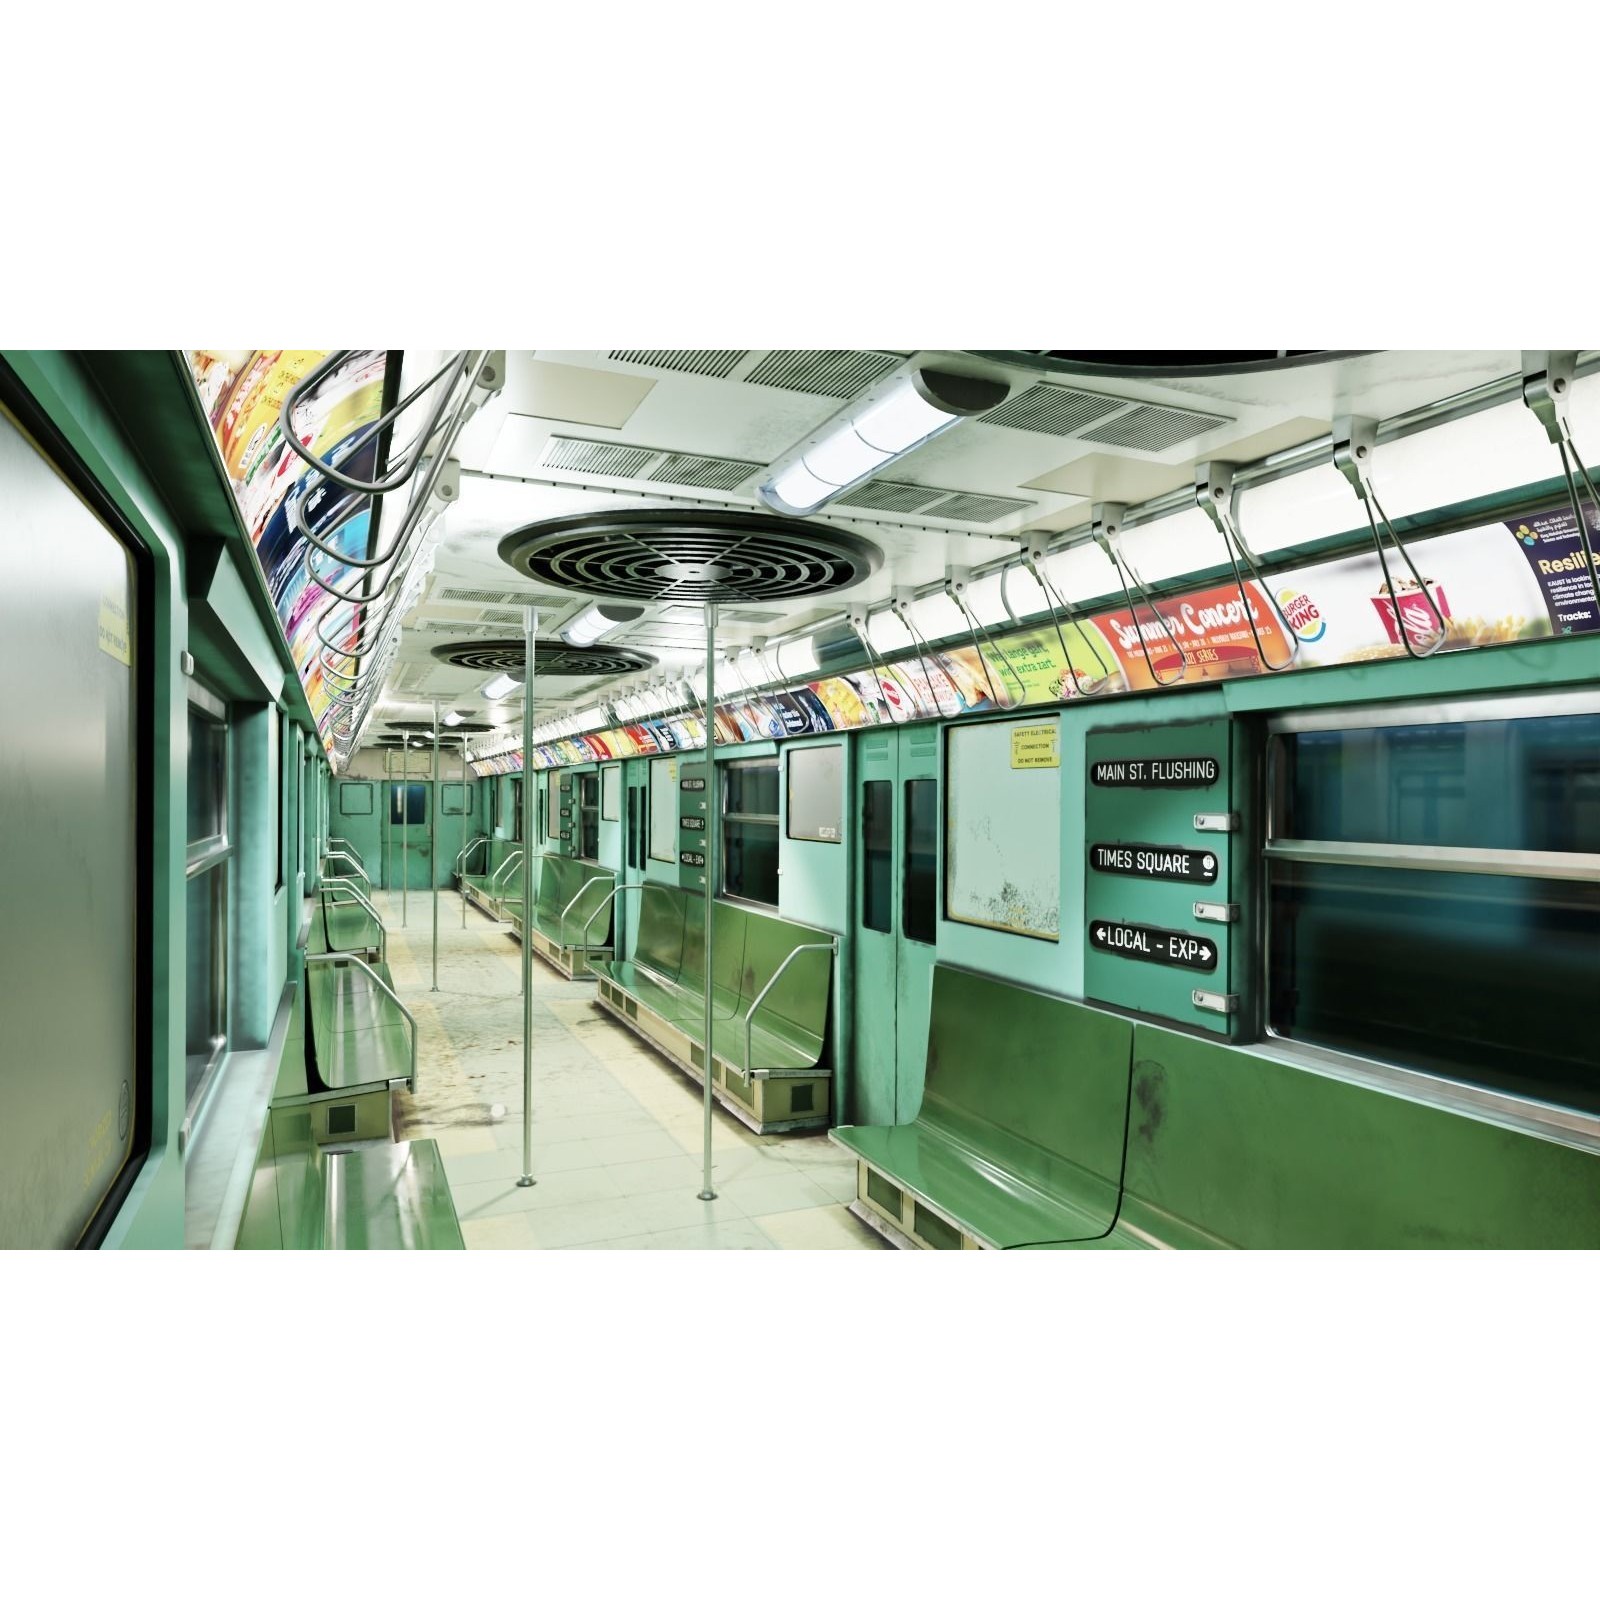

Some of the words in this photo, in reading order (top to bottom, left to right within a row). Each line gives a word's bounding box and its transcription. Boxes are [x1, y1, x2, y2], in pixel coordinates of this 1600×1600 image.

[1180, 590, 1259, 634] Concert
[1289, 604, 1319, 630] KING
[1557, 611, 1592, 622] Tracks:
[1097, 763, 1125, 781] MAIN
[1129, 762, 1147, 780] ST.
[1152, 760, 1215, 780] FLUSHING
[1098, 848, 1132, 869] TIMES
[1137, 851, 1190, 874] SQUARE
[1107, 925, 1151, 953] LOCAL
[1169, 936, 1198, 961] EXP
